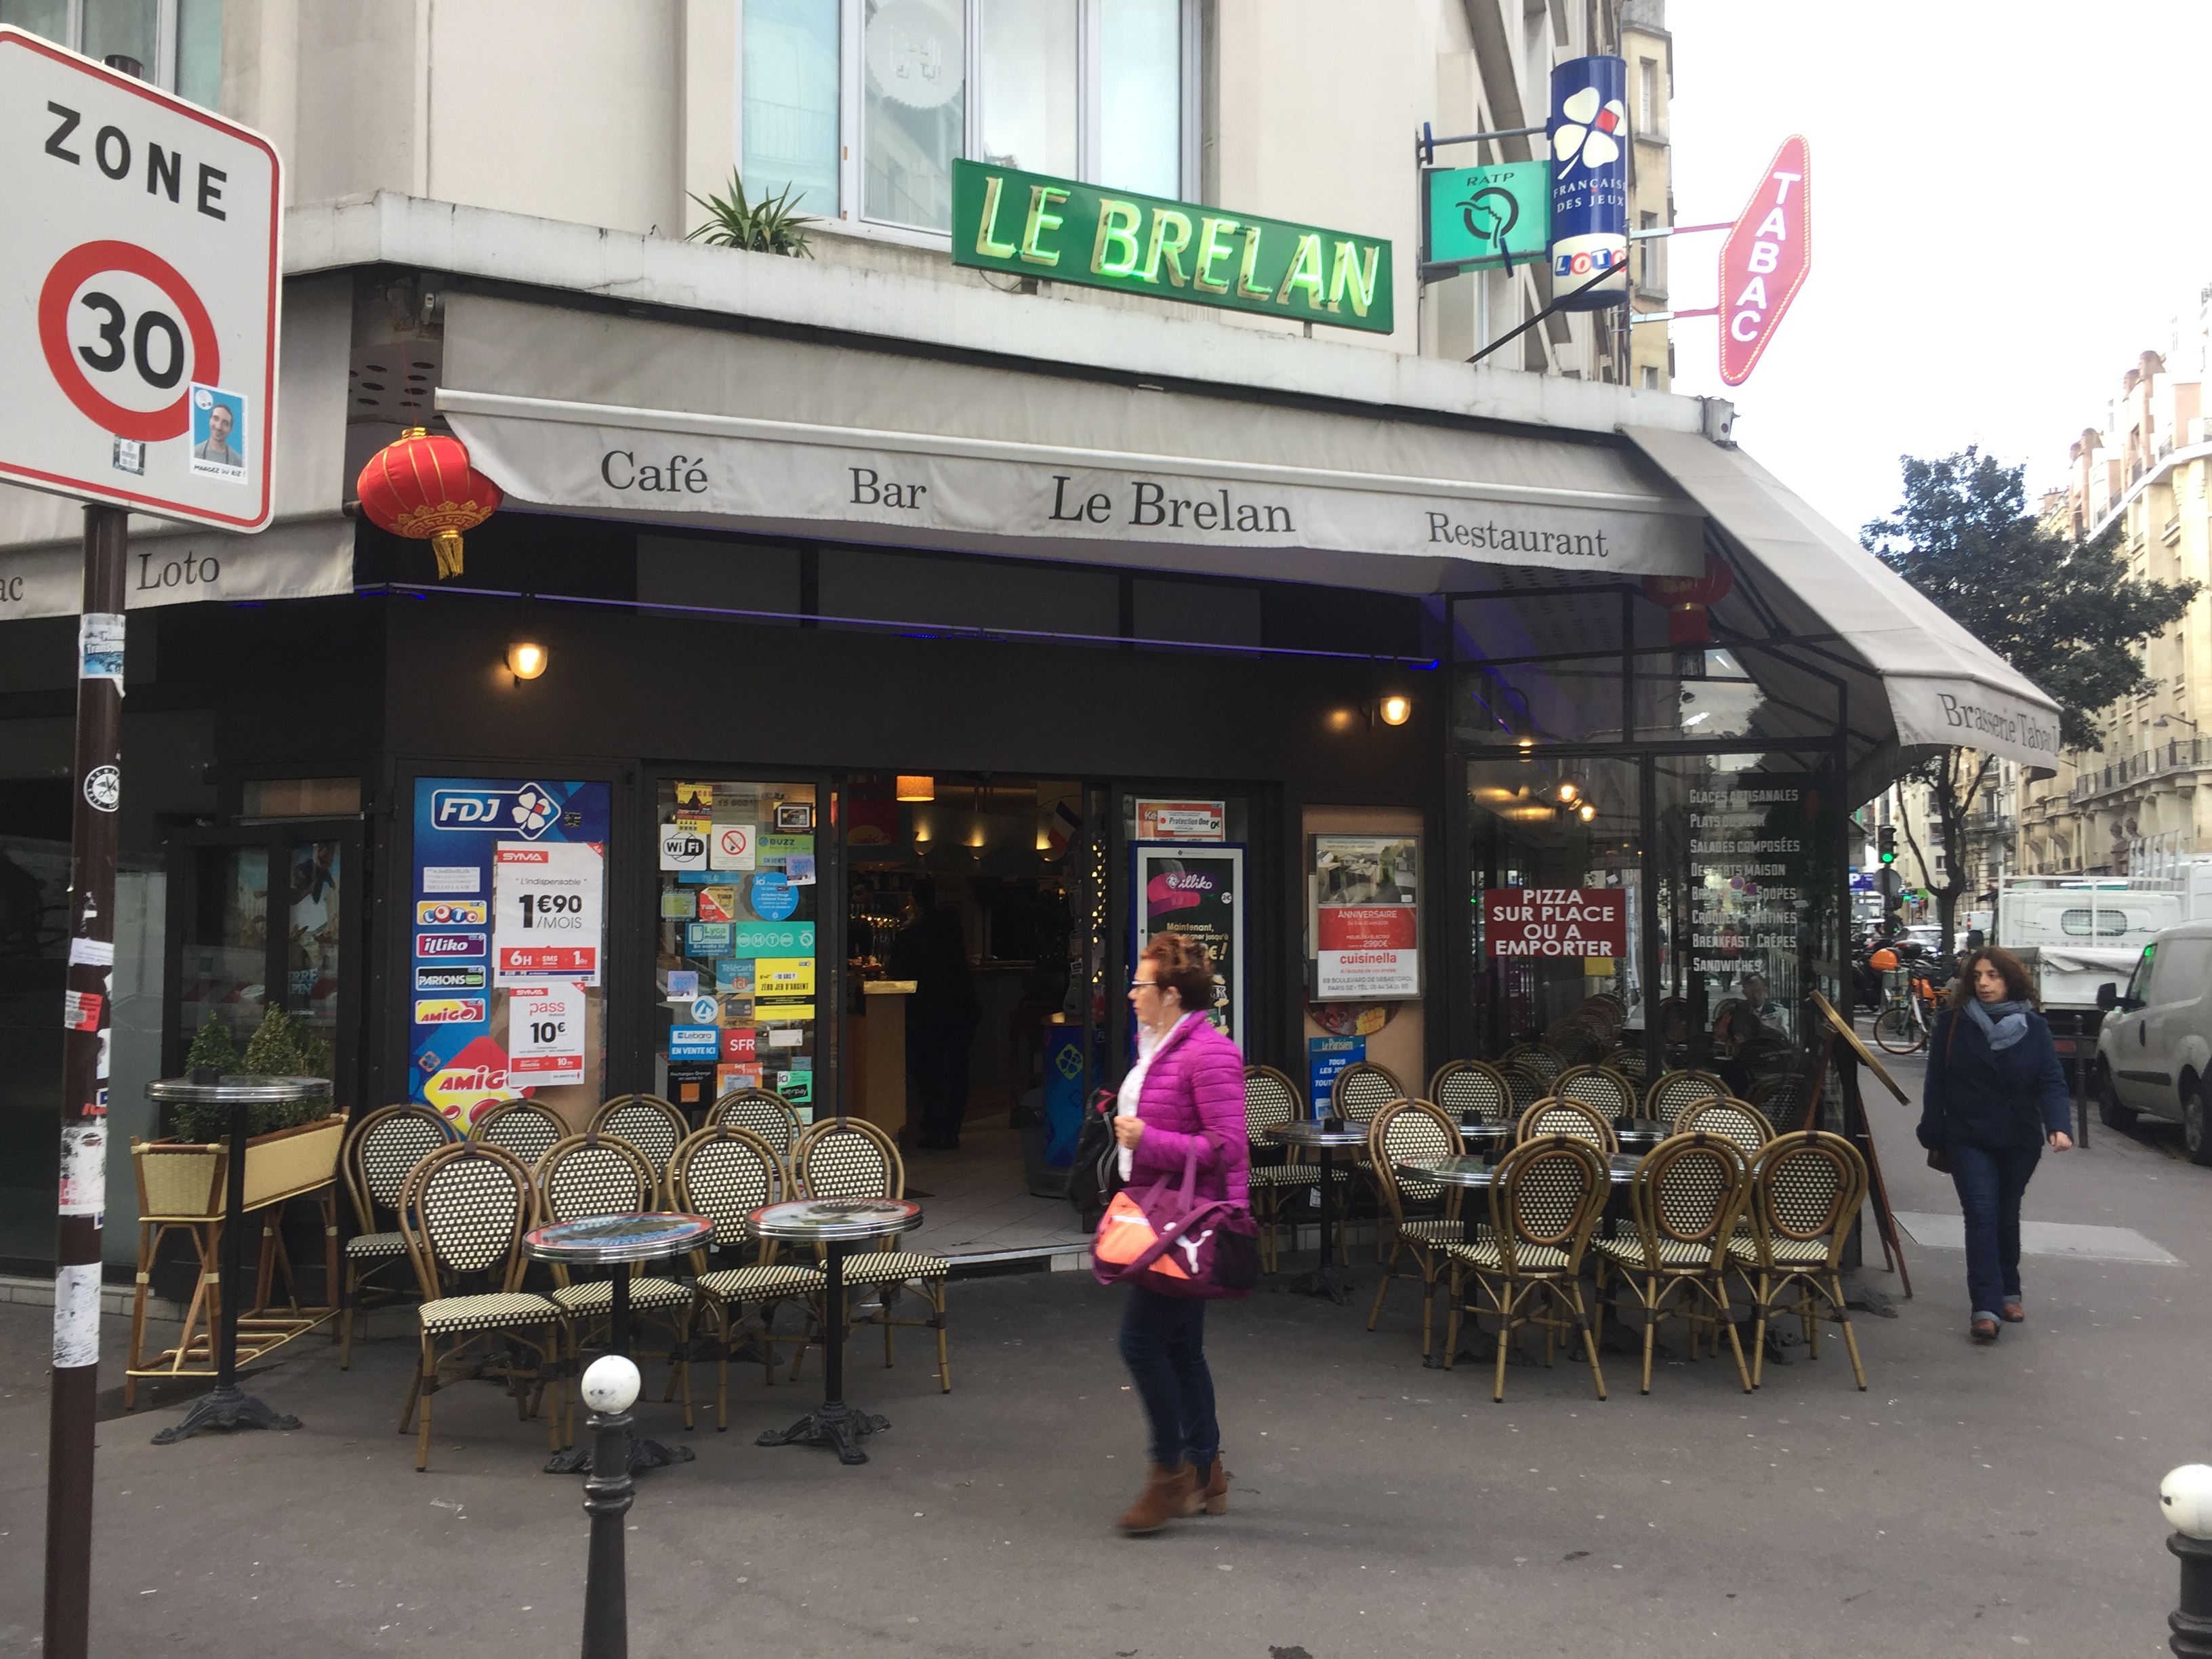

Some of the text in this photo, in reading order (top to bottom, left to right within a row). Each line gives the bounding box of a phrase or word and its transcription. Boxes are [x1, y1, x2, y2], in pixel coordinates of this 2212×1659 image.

[44, 100, 228, 222] ZONE
[1467, 172, 1515, 186] RATP
[1556, 194, 1624, 213] DES JEUX
[975, 176, 1380, 319] LE BRELAN
[1555, 248, 1626, 276] LOTO
[1729, 171, 1802, 342] TABAC
[77, 291, 185, 390] 30
[193, 464, 220, 474] MANGEZ
[600, 449, 1610, 559] Café Bar Le Brelan Restaurant
[136, 550, 220, 591] Loto
[1936, 693, 2016, 743] Brasserie
[1689, 789, 1799, 804] GLACES ARTISANALES
[439, 798, 501, 822] FDJ
[1144, 811, 1158, 820] Ke
[1690, 813, 1720, 827] PLATS
[1690, 836, 1800, 853] SALADES COMPOSÉES
[502, 853, 543, 861] SYMA
[1691, 863, 1786, 877] DESSERTS MAISON
[520, 878, 581, 886] L'indispensable
[756, 877, 766, 886] ici
[1178, 874, 1213, 889] illiko
[1523, 889, 1584, 905] PIZZA
[1757, 885, 1797, 901] SOUPES
[423, 903, 478, 923] LOTO
[1337, 910, 1397, 918] ANNIVERSAIRE
[1492, 906, 1614, 922] SUR PLACE
[1692, 909, 1739, 925] CROQUES
[536, 916, 583, 929] /MOIS
[704, 926, 726, 934] Lyca
[1166, 922, 1214, 933] Maintenant,
[1523, 924, 1582, 940] OU A
[424, 937, 469, 954] illiko
[1495, 940, 1613, 956] EMPORTER
[1692, 933, 1797, 948] BREAKFAST CRÊPES
[510, 950, 533, 966] 6H
[1340, 952, 1397, 964] cuisinella
[1693, 958, 1762, 972] SANDWICHES
[418, 976, 466, 986] PARIONS
[761, 982, 809, 991] ZÉRO JEU D'ARGENT
[530, 1002, 565, 1016] pass
[530, 1022, 566, 1044] 10€
[672, 1047, 682, 1055] EN
[730, 1039, 756, 1051] SFR
[1322, 1038, 1353, 1050] Le Parisien
